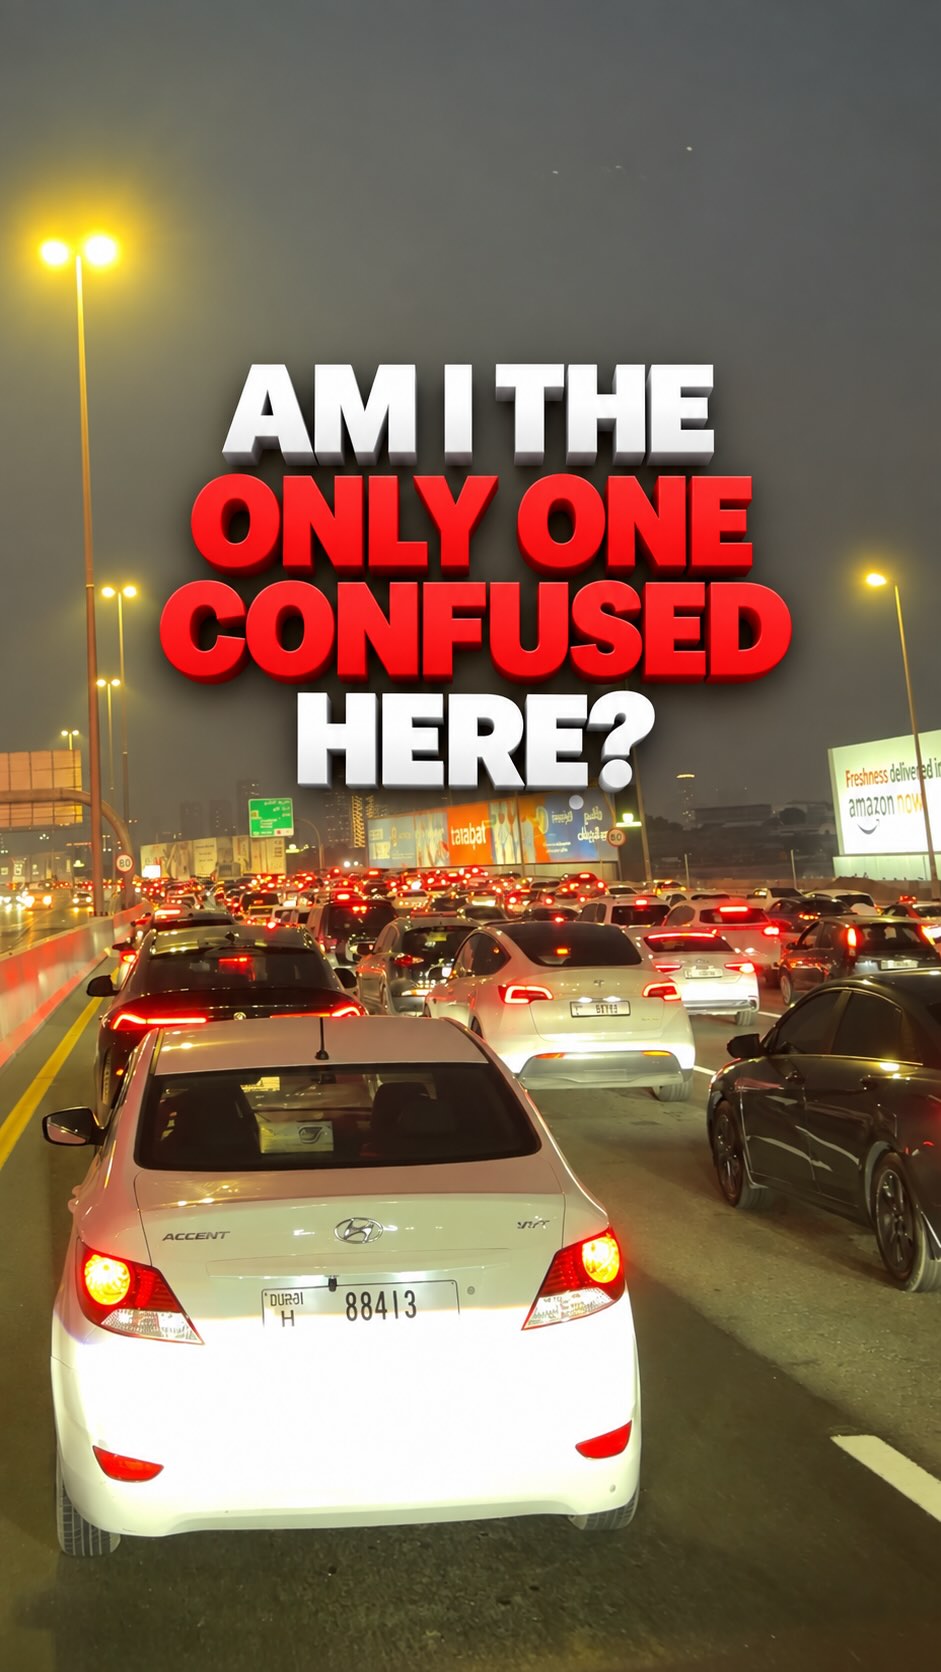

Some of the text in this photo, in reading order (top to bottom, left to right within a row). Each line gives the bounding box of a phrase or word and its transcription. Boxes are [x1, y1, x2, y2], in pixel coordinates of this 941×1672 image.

[845, 768, 889, 788] Freshness
[848, 794, 895, 818] amazon
[162, 1231, 231, 1242] ACCENT
[345, 1290, 417, 1322] 88413
[281, 1310, 295, 1328] H
